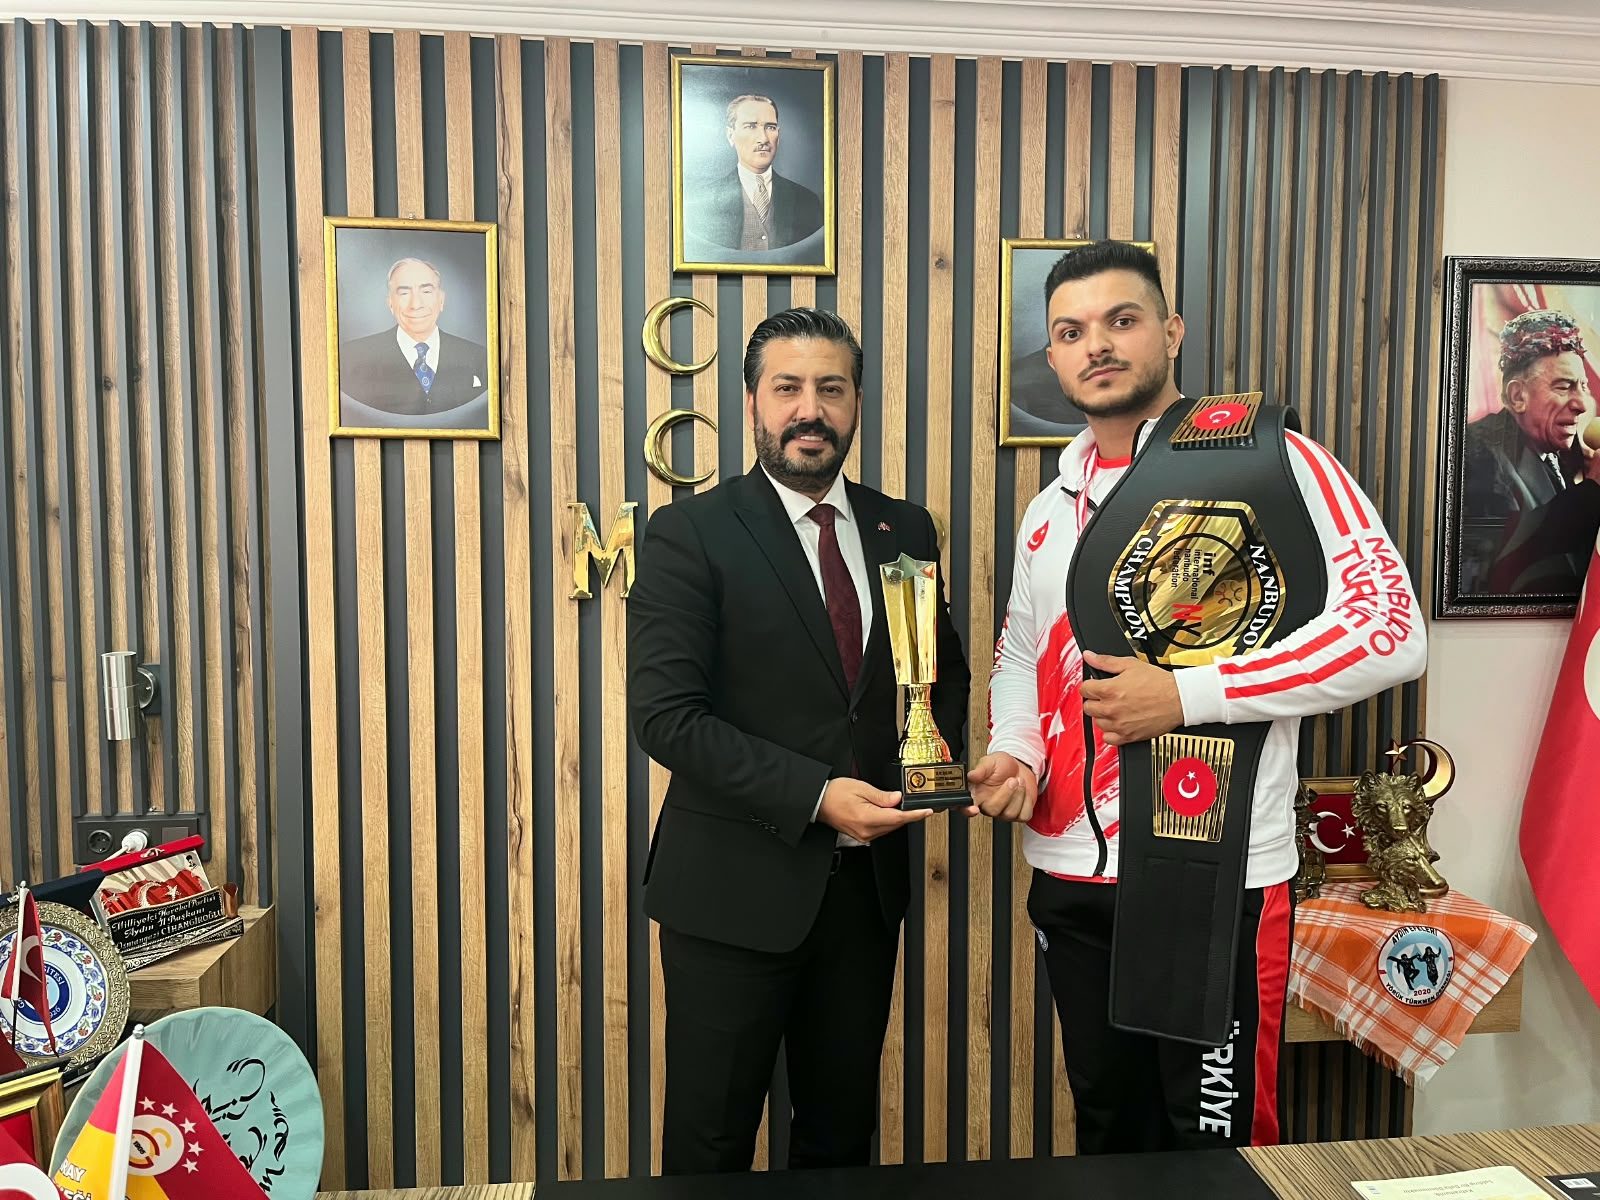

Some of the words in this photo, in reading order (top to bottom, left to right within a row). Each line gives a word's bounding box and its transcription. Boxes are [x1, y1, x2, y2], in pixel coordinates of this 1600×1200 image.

[567, 502, 638, 599] M
[1182, 548, 1192, 582] nanbudo
[1191, 549, 1202, 599] international
[1203, 552, 1216, 576] inf
[1114, 537, 1154, 641] CHAMPION
[1243, 544, 1279, 646] NANBUDO
[1405, 995, 1436, 1005] TÜRKMEN
[1413, 988, 1432, 997] 2020
[1200, 1021, 1240, 1138] RKİYE
